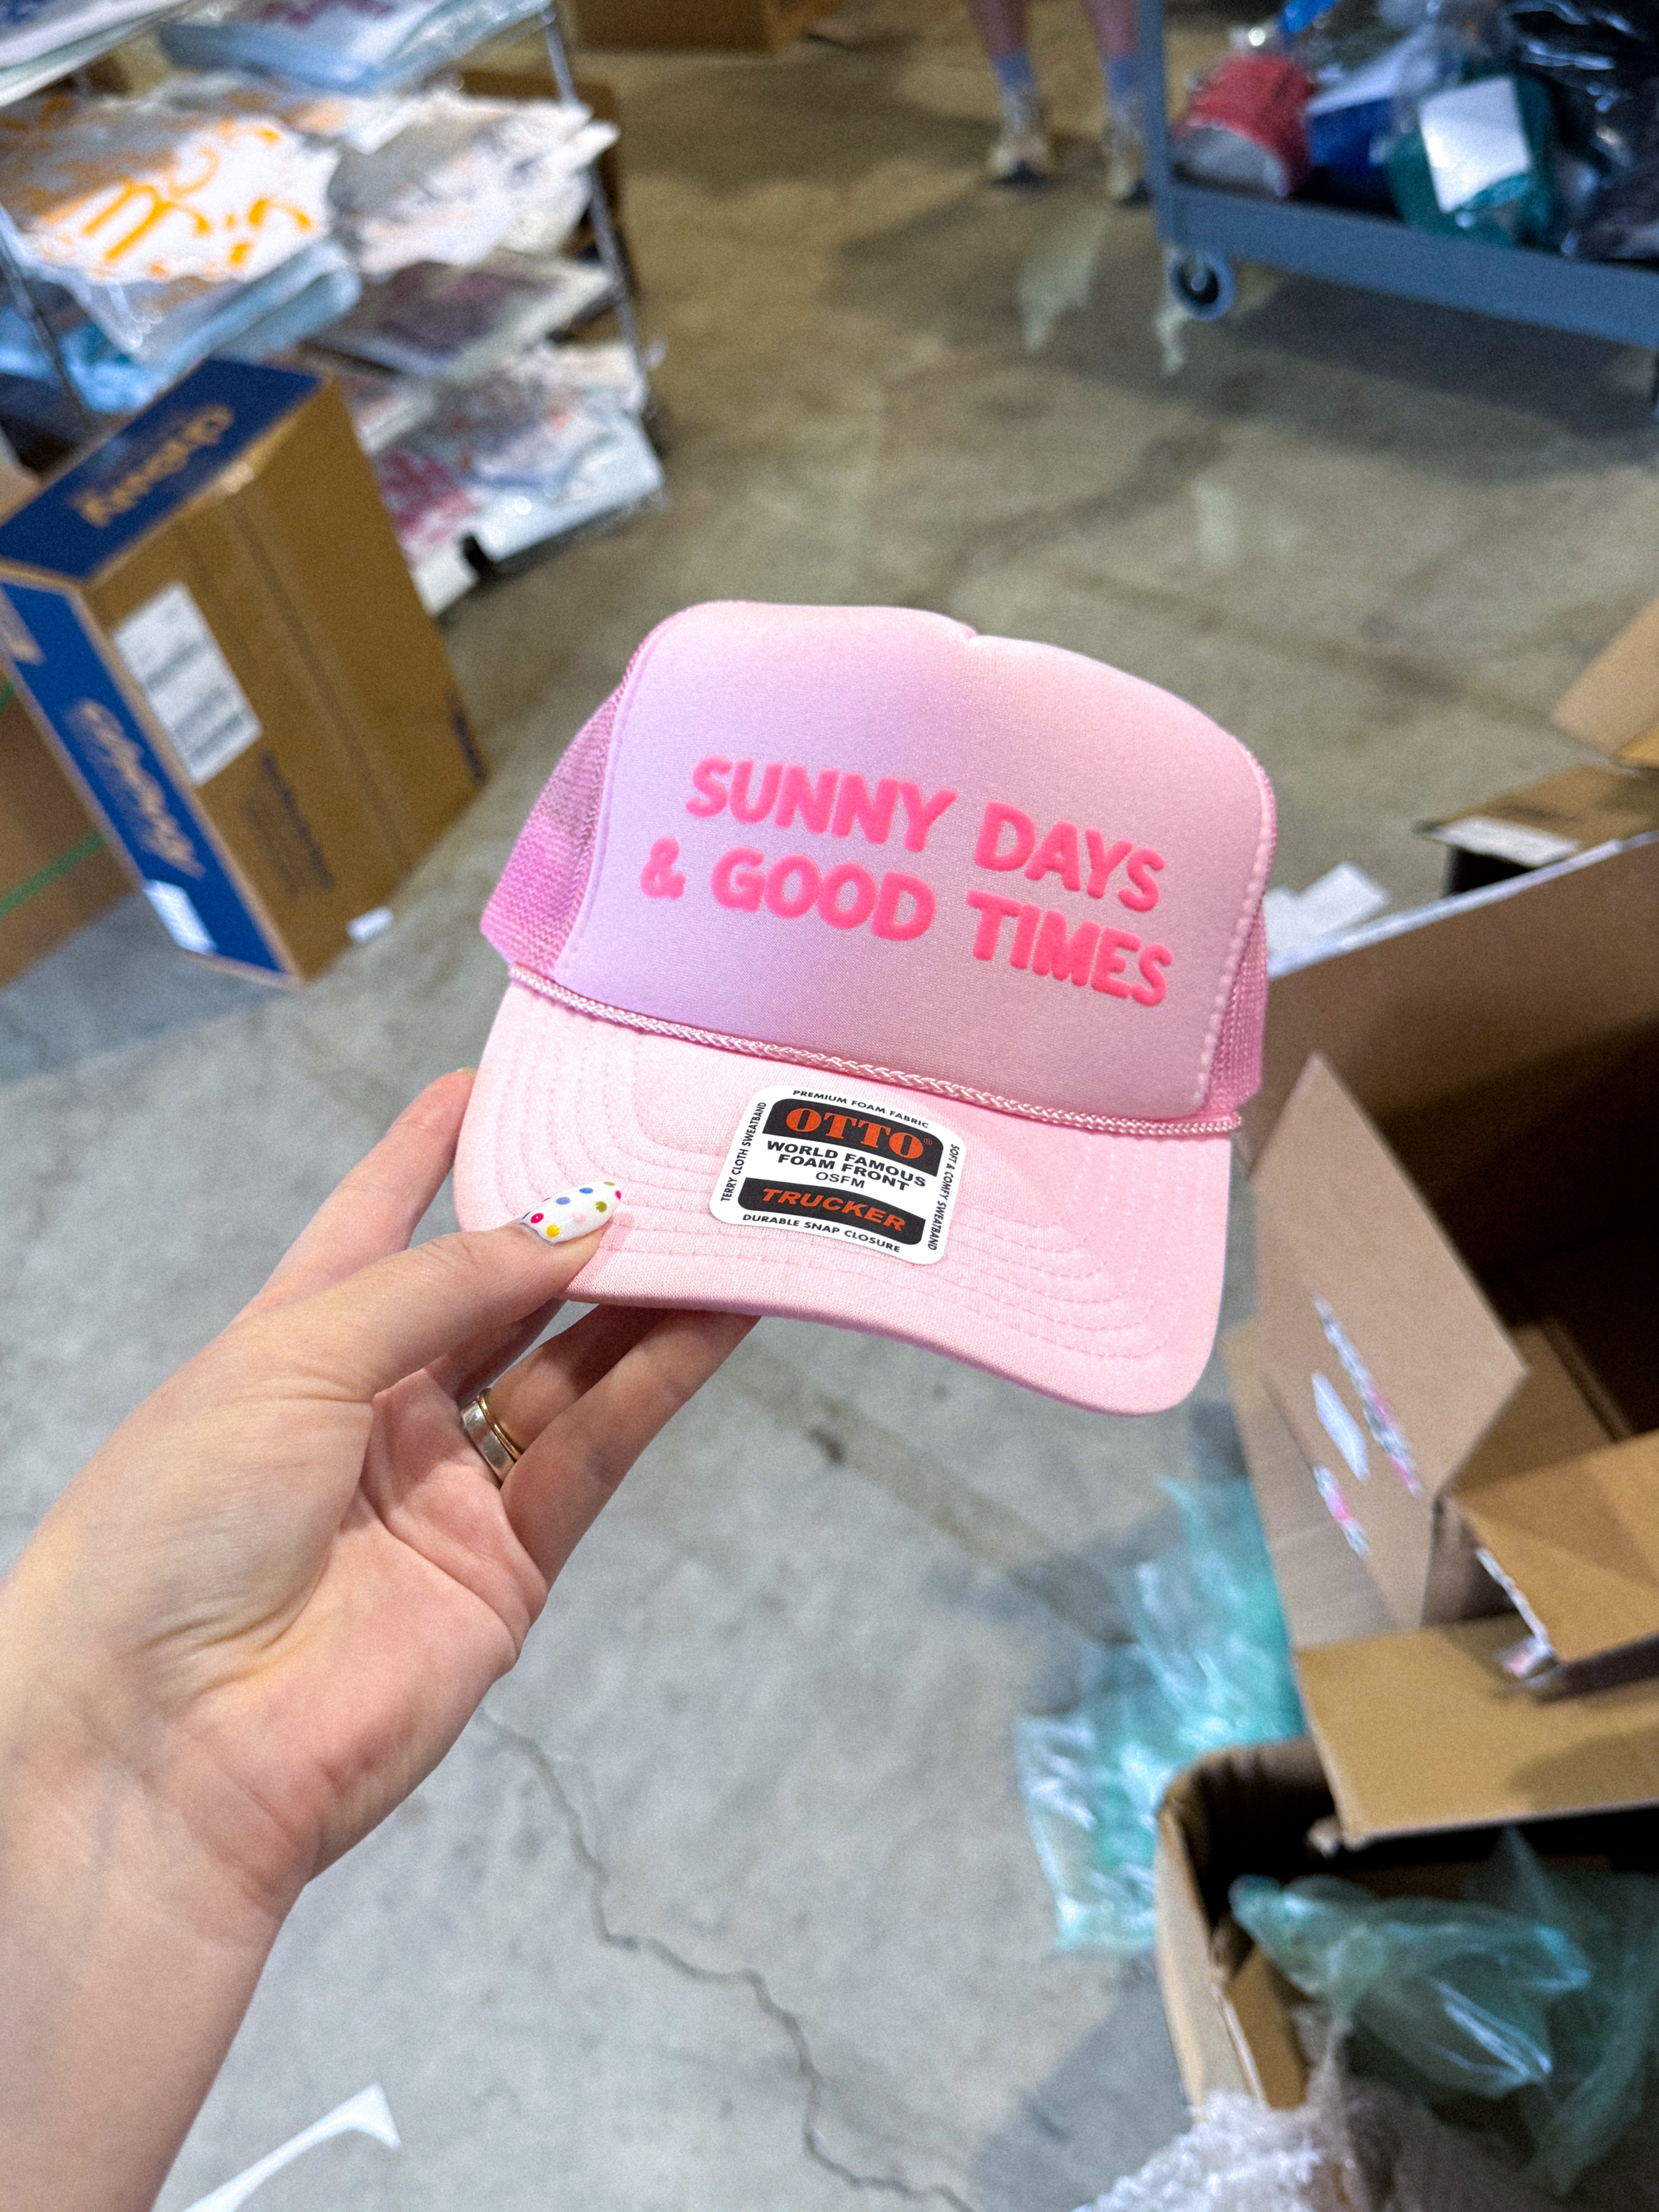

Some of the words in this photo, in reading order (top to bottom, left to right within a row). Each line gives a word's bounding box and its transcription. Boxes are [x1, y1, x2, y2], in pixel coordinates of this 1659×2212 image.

[685, 756, 958, 853] SUNNY
[974, 801, 1165, 913] DAYS
[640, 836, 685, 900] &
[710, 845, 936, 941] GOOD
[966, 889, 1173, 1006] TIMES
[793, 1090, 847, 1104] PREMIUM
[851, 1100, 885, 1114] FOAM
[889, 1110, 929, 1128] FABRIC
[721, 1177, 738, 1201] TERRY
[731, 1149, 749, 1175] CLOTH
[741, 1102, 767, 1147] SWEATBAND
[785, 1108, 923, 1159] OTTO
[948, 1144, 960, 1164] SOFT
[767, 1140, 838, 1159] WORLD
[844, 1153, 926, 1187] FAMOUS
[778, 1154, 835, 1170] FOAM
[841, 1163, 910, 1191] FRONT
[816, 1172, 865, 1188] OSFM
[939, 1171, 954, 1201] COMFY
[762, 1188, 905, 1232] TRUCKER
[928, 1201, 947, 1251] SWEATBAND
[742, 1214, 800, 1227] DURABLE
[804, 1221, 840, 1234] SNAP
[844, 1230, 901, 1253] CLOSURE
